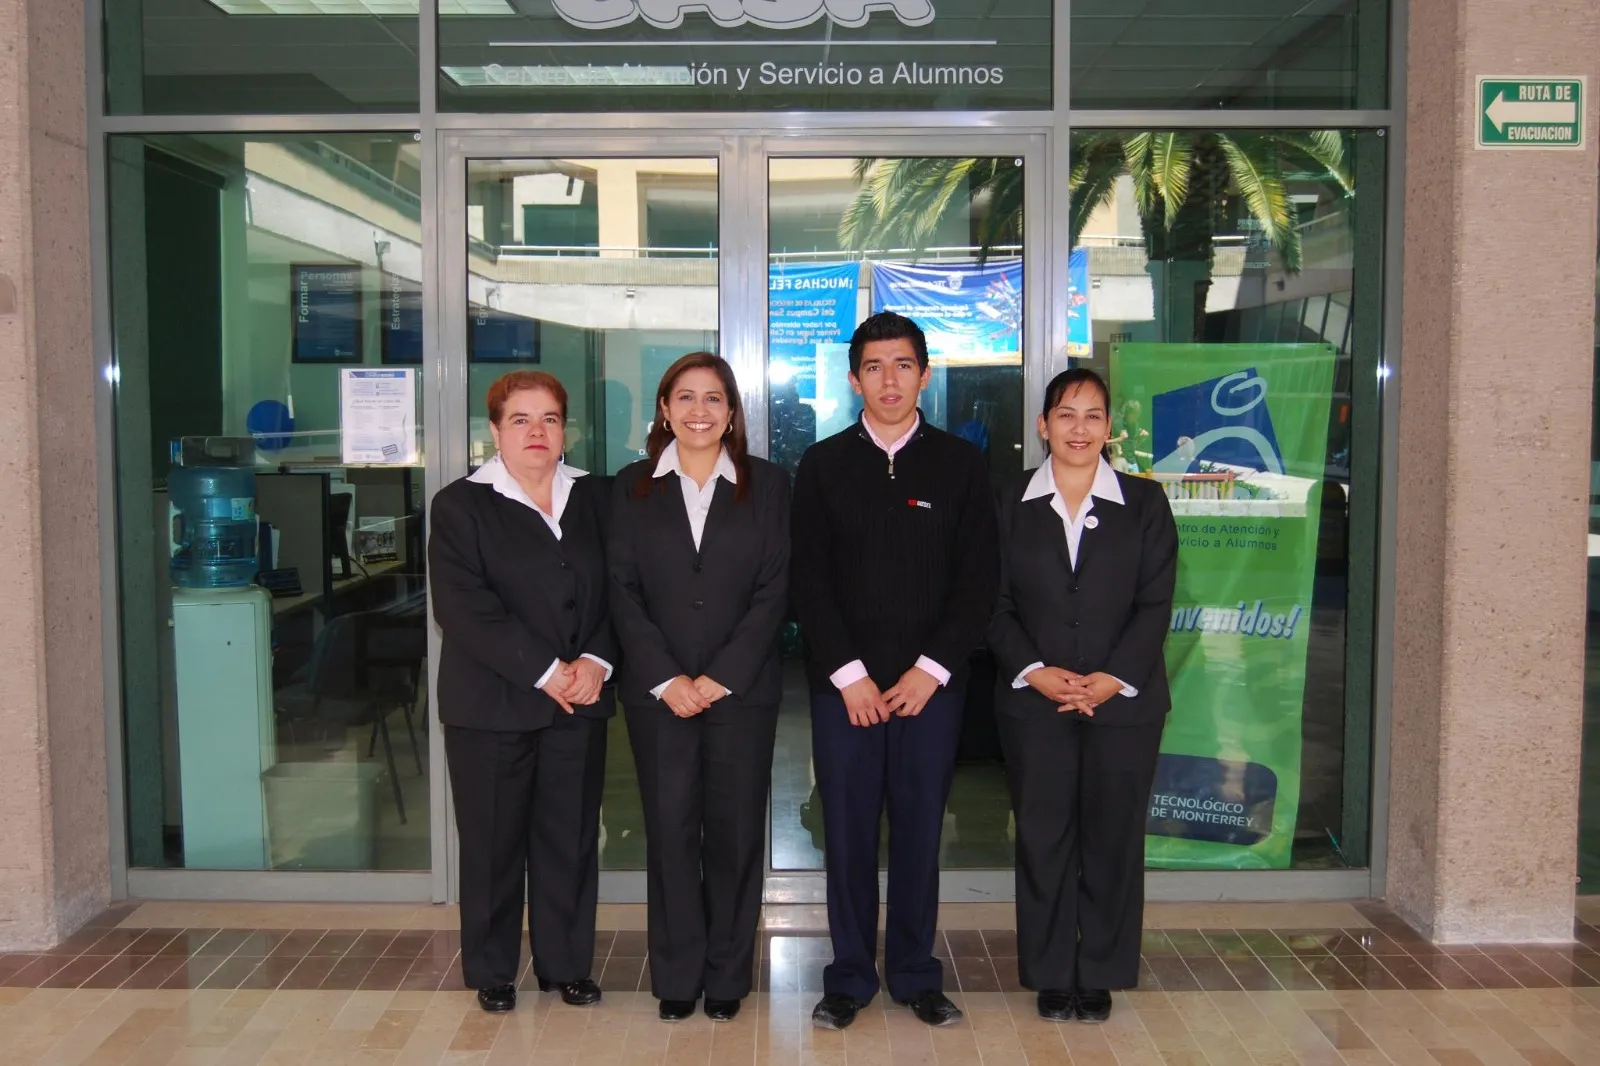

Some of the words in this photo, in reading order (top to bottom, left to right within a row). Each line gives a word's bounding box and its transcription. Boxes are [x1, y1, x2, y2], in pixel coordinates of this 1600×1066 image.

[737, 67, 750, 90] y
[759, 62, 862, 85] Servicio
[869, 67, 883, 84] a
[892, 62, 1004, 84] Alumnos
[1519, 85, 1551, 101] RUTA
[1555, 85, 1571, 100] DE
[299, 281, 309, 323] Formar
[1202, 524, 1216, 533] de
[1273, 528, 1279, 539] y
[1214, 539, 1220, 547] a
[1226, 538, 1276, 550] Alumnos
[1154, 795, 1244, 814] TECNOLÓGICO
[1151, 807, 1167, 818] DE
[1172, 810, 1253, 827] MONTERREY
